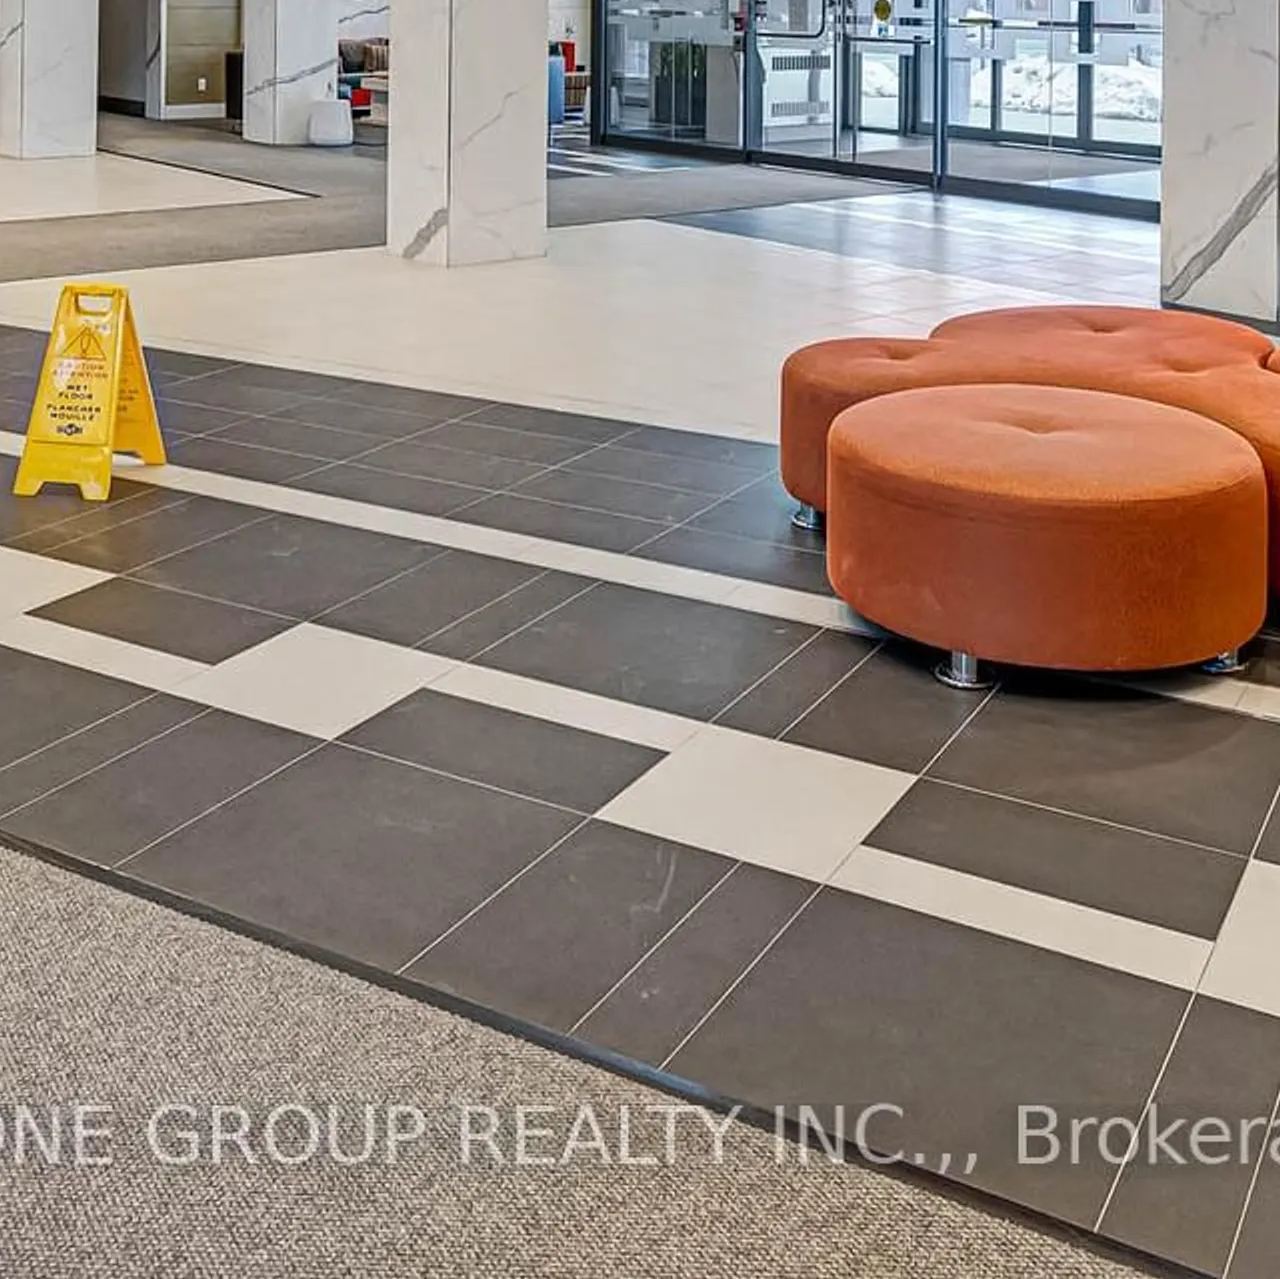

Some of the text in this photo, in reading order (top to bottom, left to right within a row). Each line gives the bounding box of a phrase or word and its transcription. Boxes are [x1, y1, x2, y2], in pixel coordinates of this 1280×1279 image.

[66, 384, 88, 392] WET
[58, 392, 93, 400] FLOOR
[46, 403, 101, 413] PLANCHER
